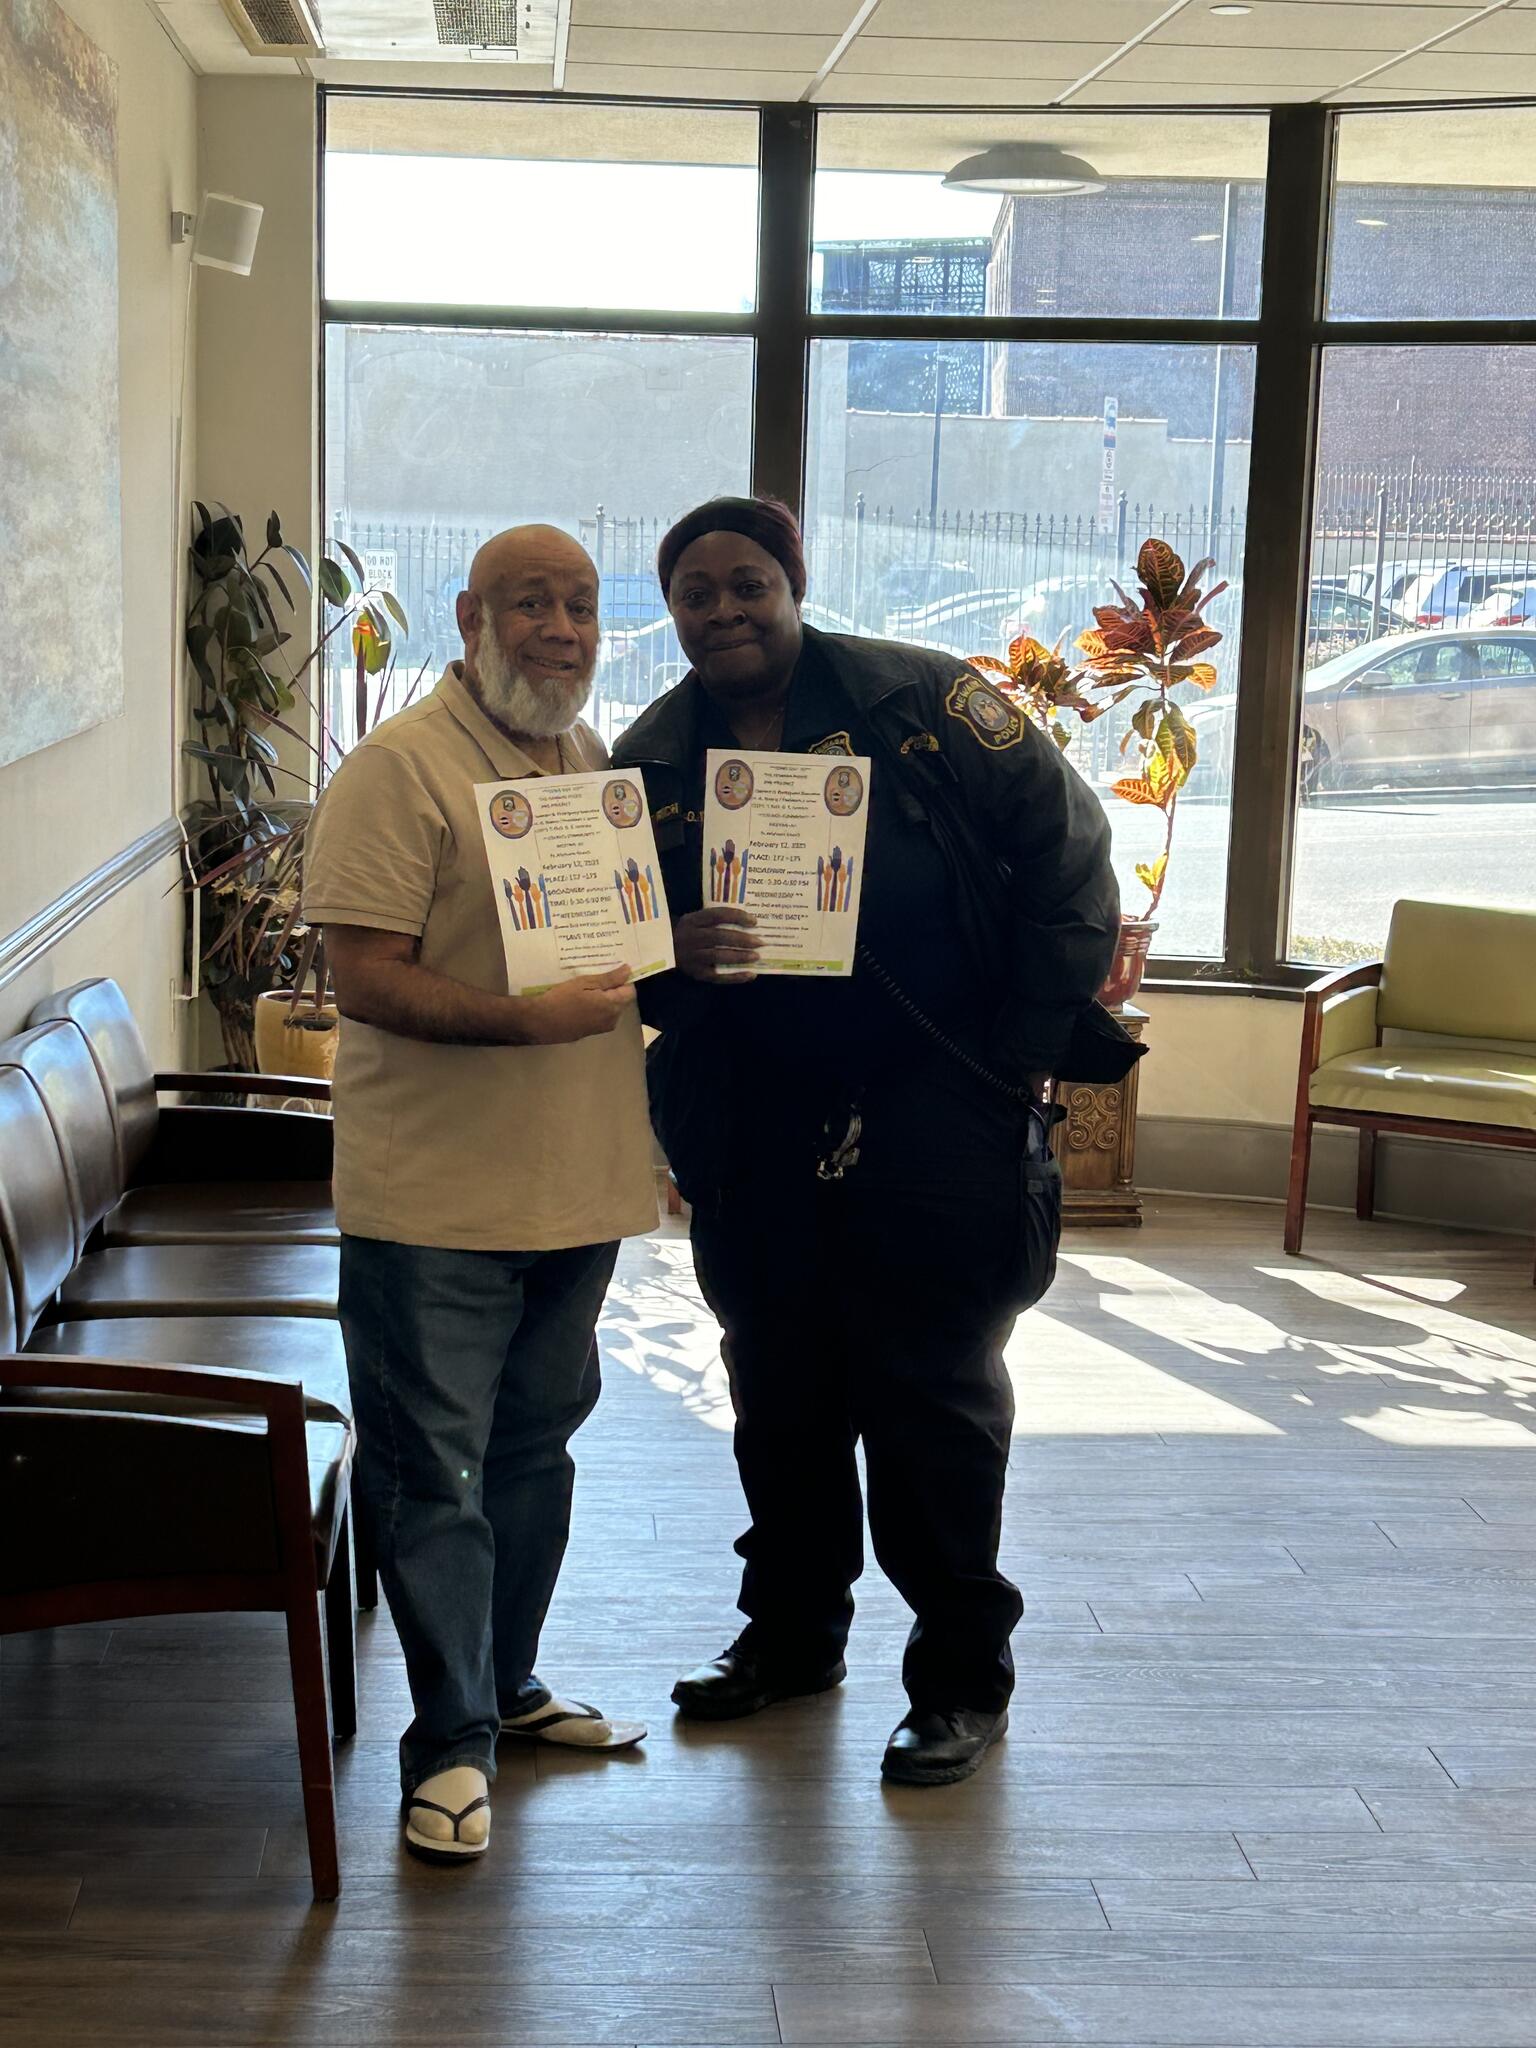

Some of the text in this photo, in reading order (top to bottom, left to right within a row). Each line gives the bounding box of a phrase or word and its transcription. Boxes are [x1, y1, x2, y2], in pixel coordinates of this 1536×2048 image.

[367, 556, 393, 566] DO NOT
[368, 569, 392, 579] BLOCK
[749, 840, 779, 849] February
[542, 862, 573, 871] February
